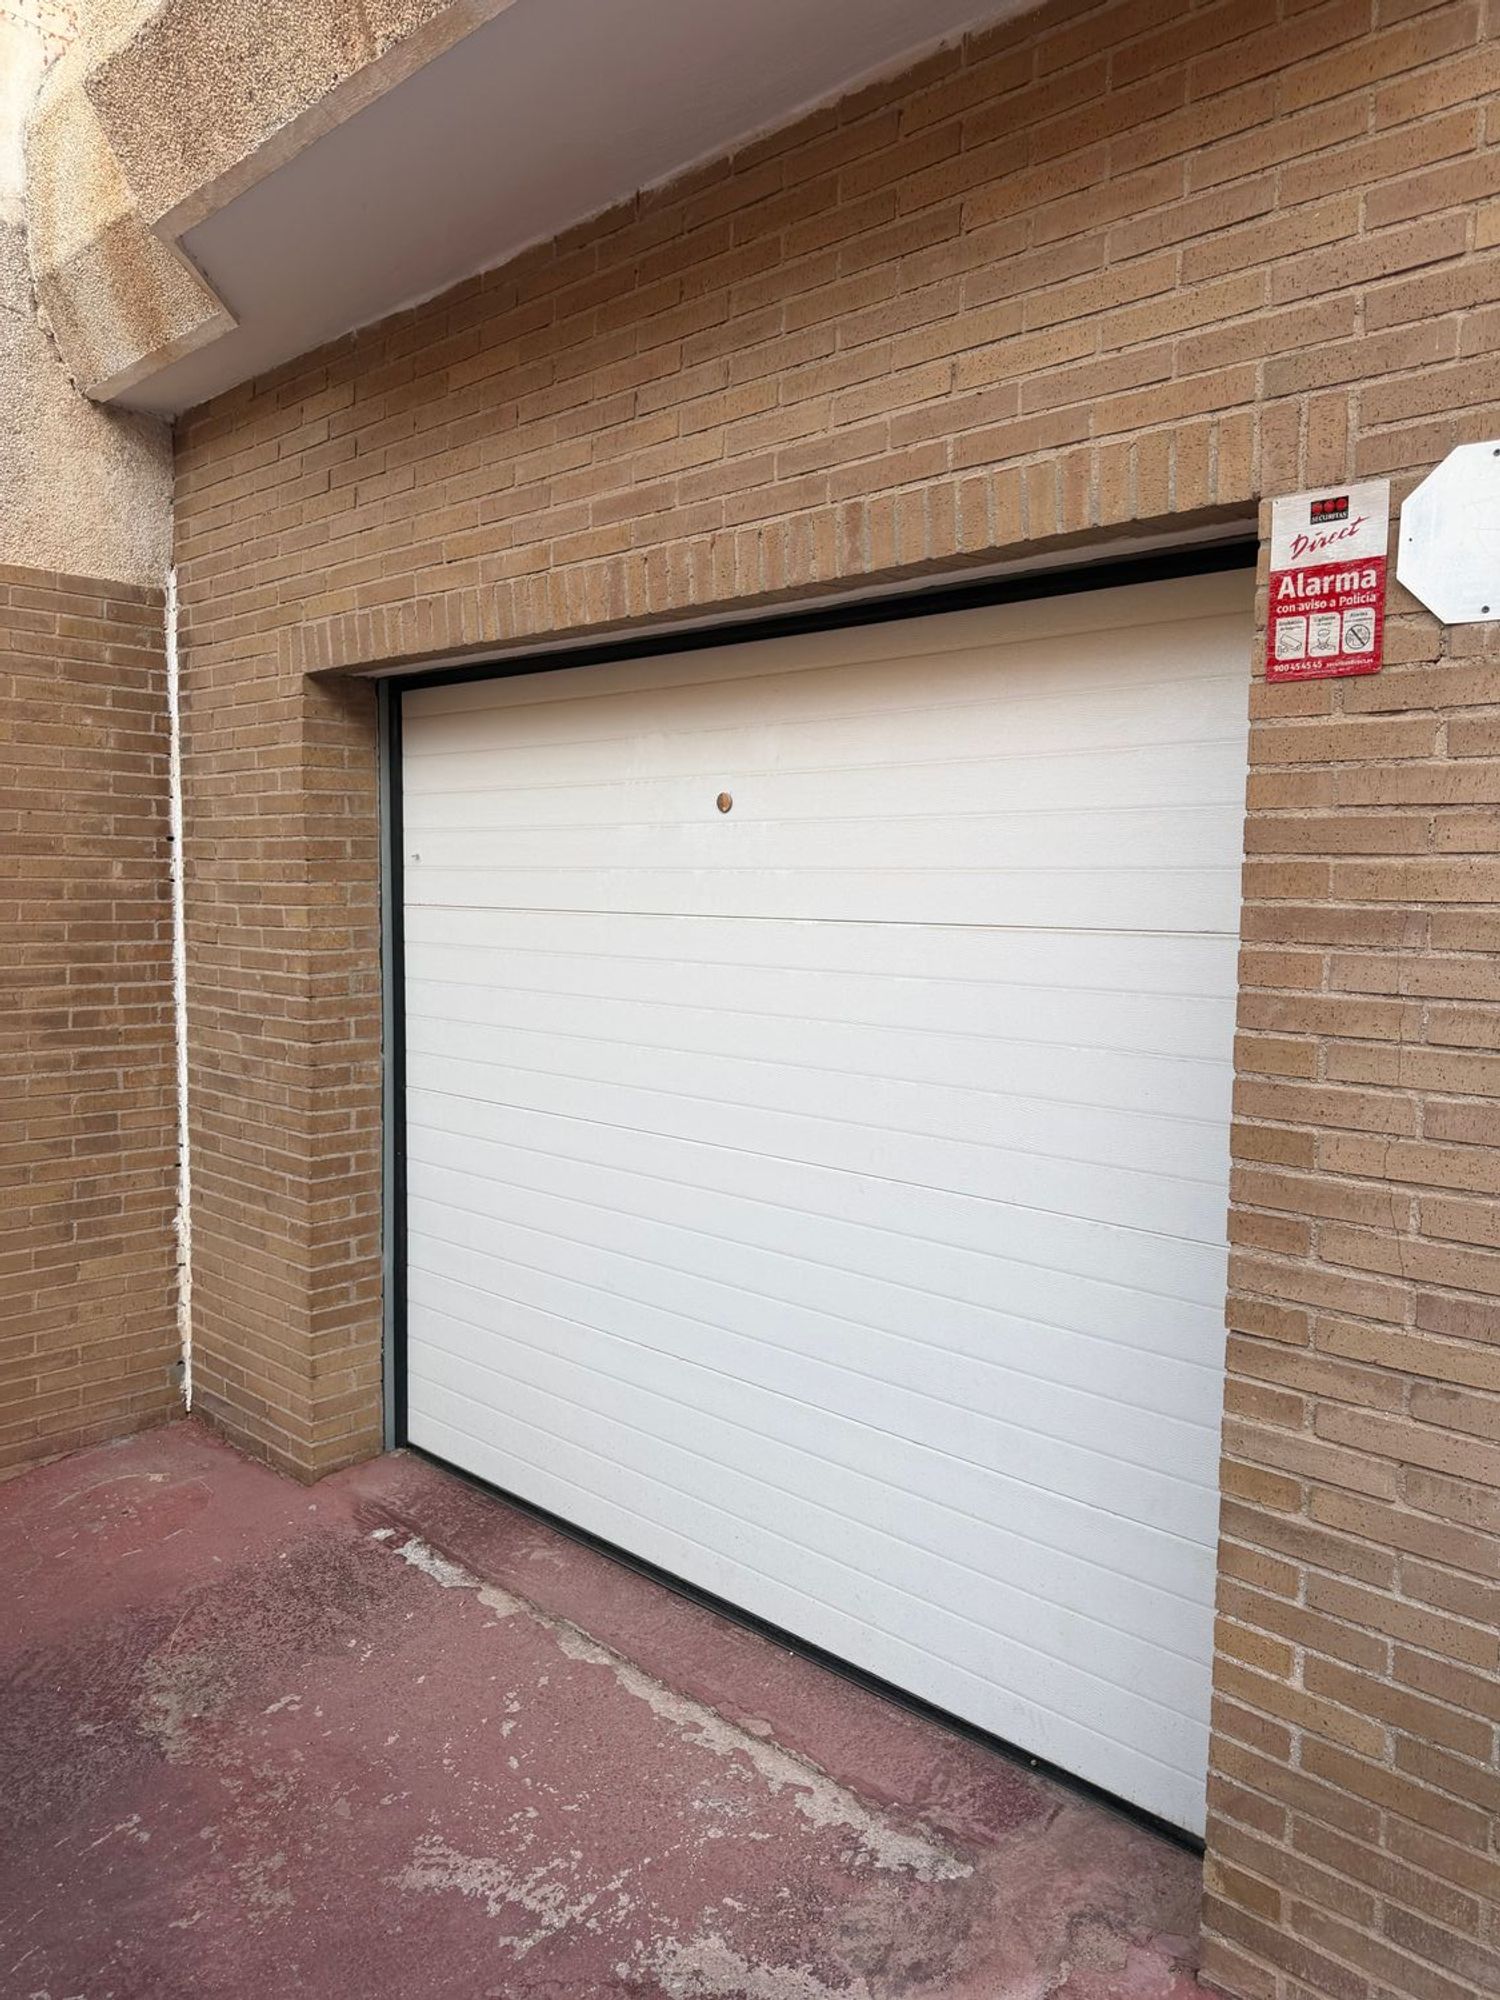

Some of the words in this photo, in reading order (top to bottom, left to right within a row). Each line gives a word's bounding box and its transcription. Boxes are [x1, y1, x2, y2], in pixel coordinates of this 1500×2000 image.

[1312, 510, 1347, 522] SECURITAS
[1290, 516, 1370, 560] Direct
[1277, 568, 1377, 600] Alarma
[1276, 604, 1296, 614] con
[1298, 599, 1327, 612] aviso
[1329, 600, 1336, 608] a
